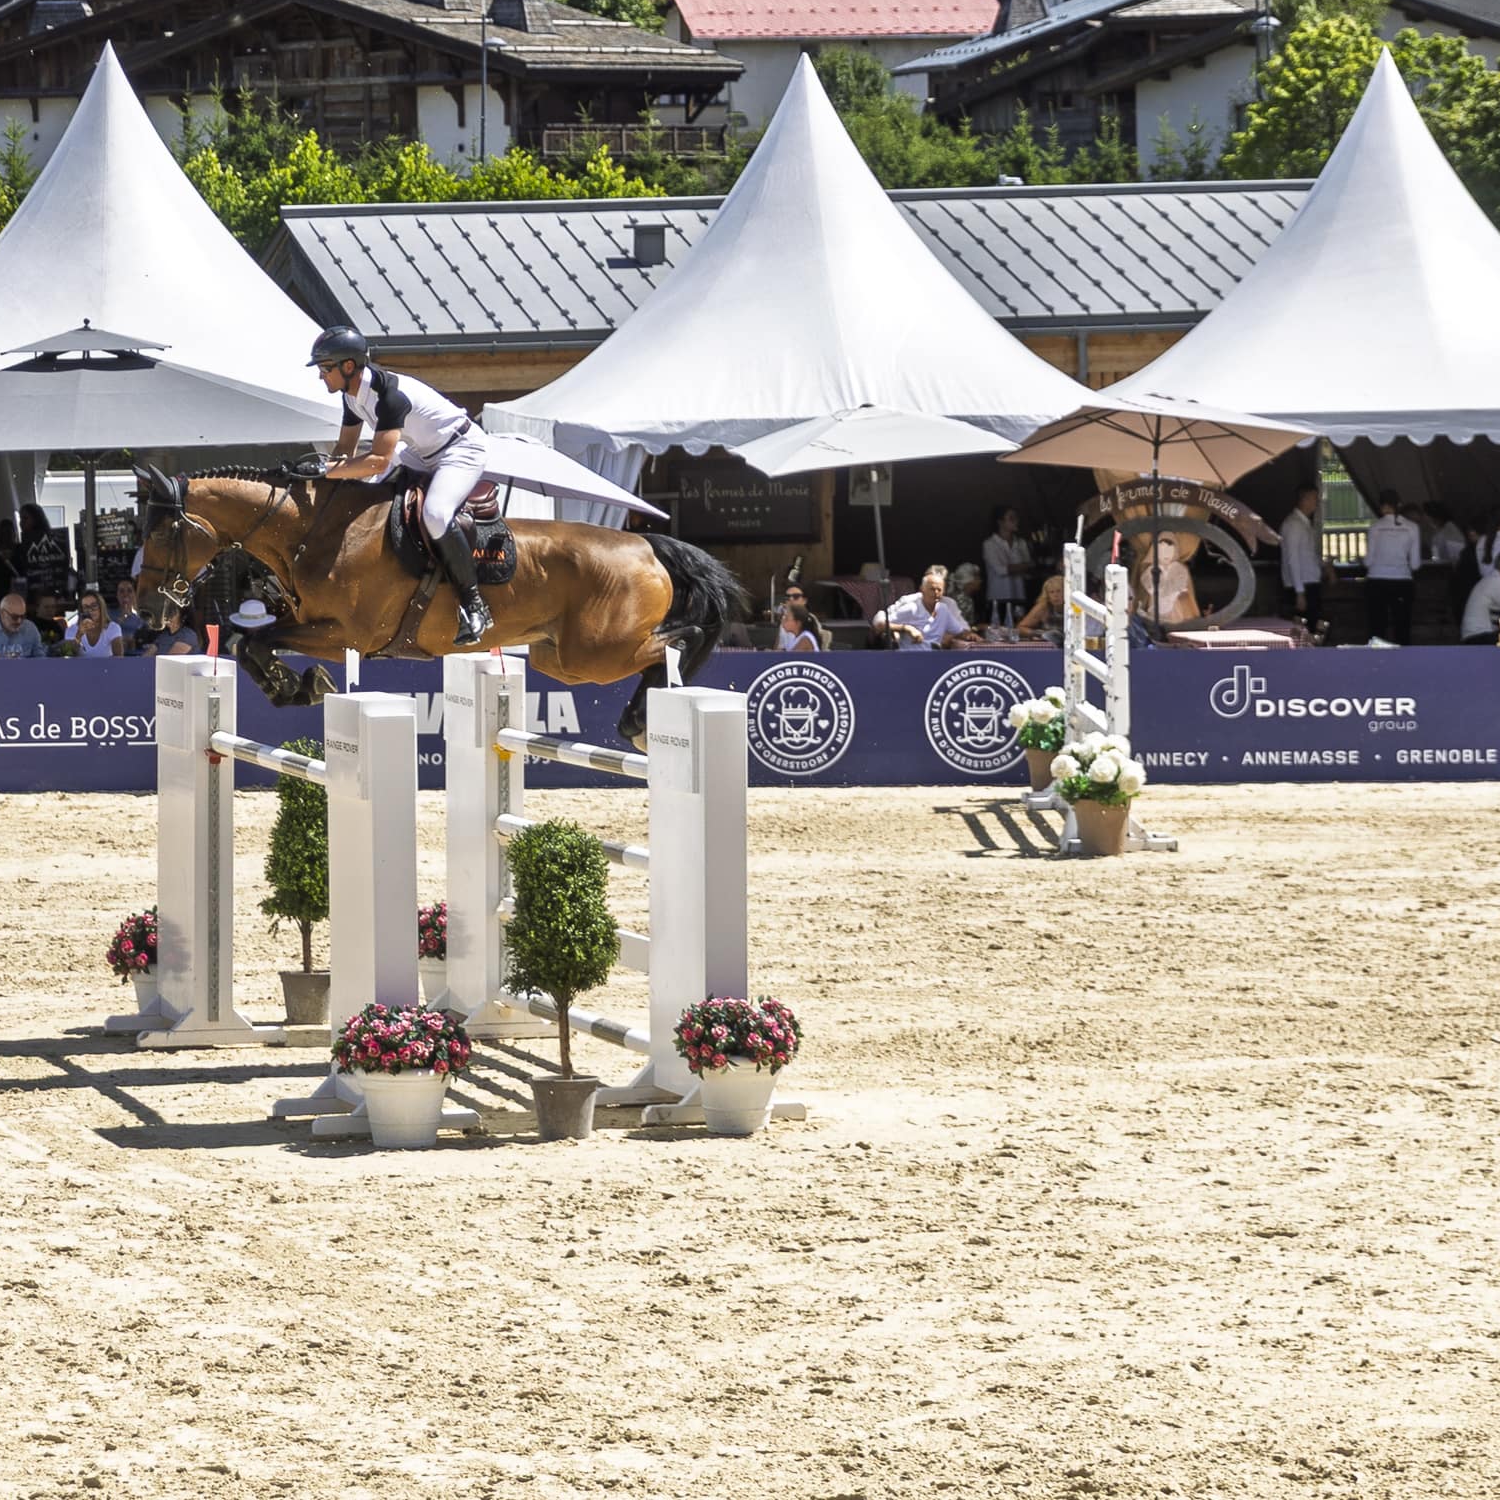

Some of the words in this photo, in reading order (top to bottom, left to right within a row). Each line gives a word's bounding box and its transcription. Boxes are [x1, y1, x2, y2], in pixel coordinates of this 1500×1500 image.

[1170, 485, 1189, 499] de
[1199, 489, 1239, 519] Marie
[761, 667, 799, 690] AMORE
[802, 667, 836, 690] HIBOU
[945, 666, 983, 688] AMORE
[986, 666, 1020, 689] HIBOU
[1255, 697, 1417, 718] DISCOVER
[29, 703, 61, 739] de
[70, 715, 156, 739] BOSSY
[1368, 719, 1418, 732] group
[1241, 750, 1360, 765] ANNEMASSE
[1396, 749, 1498, 765] GRENOBLE
